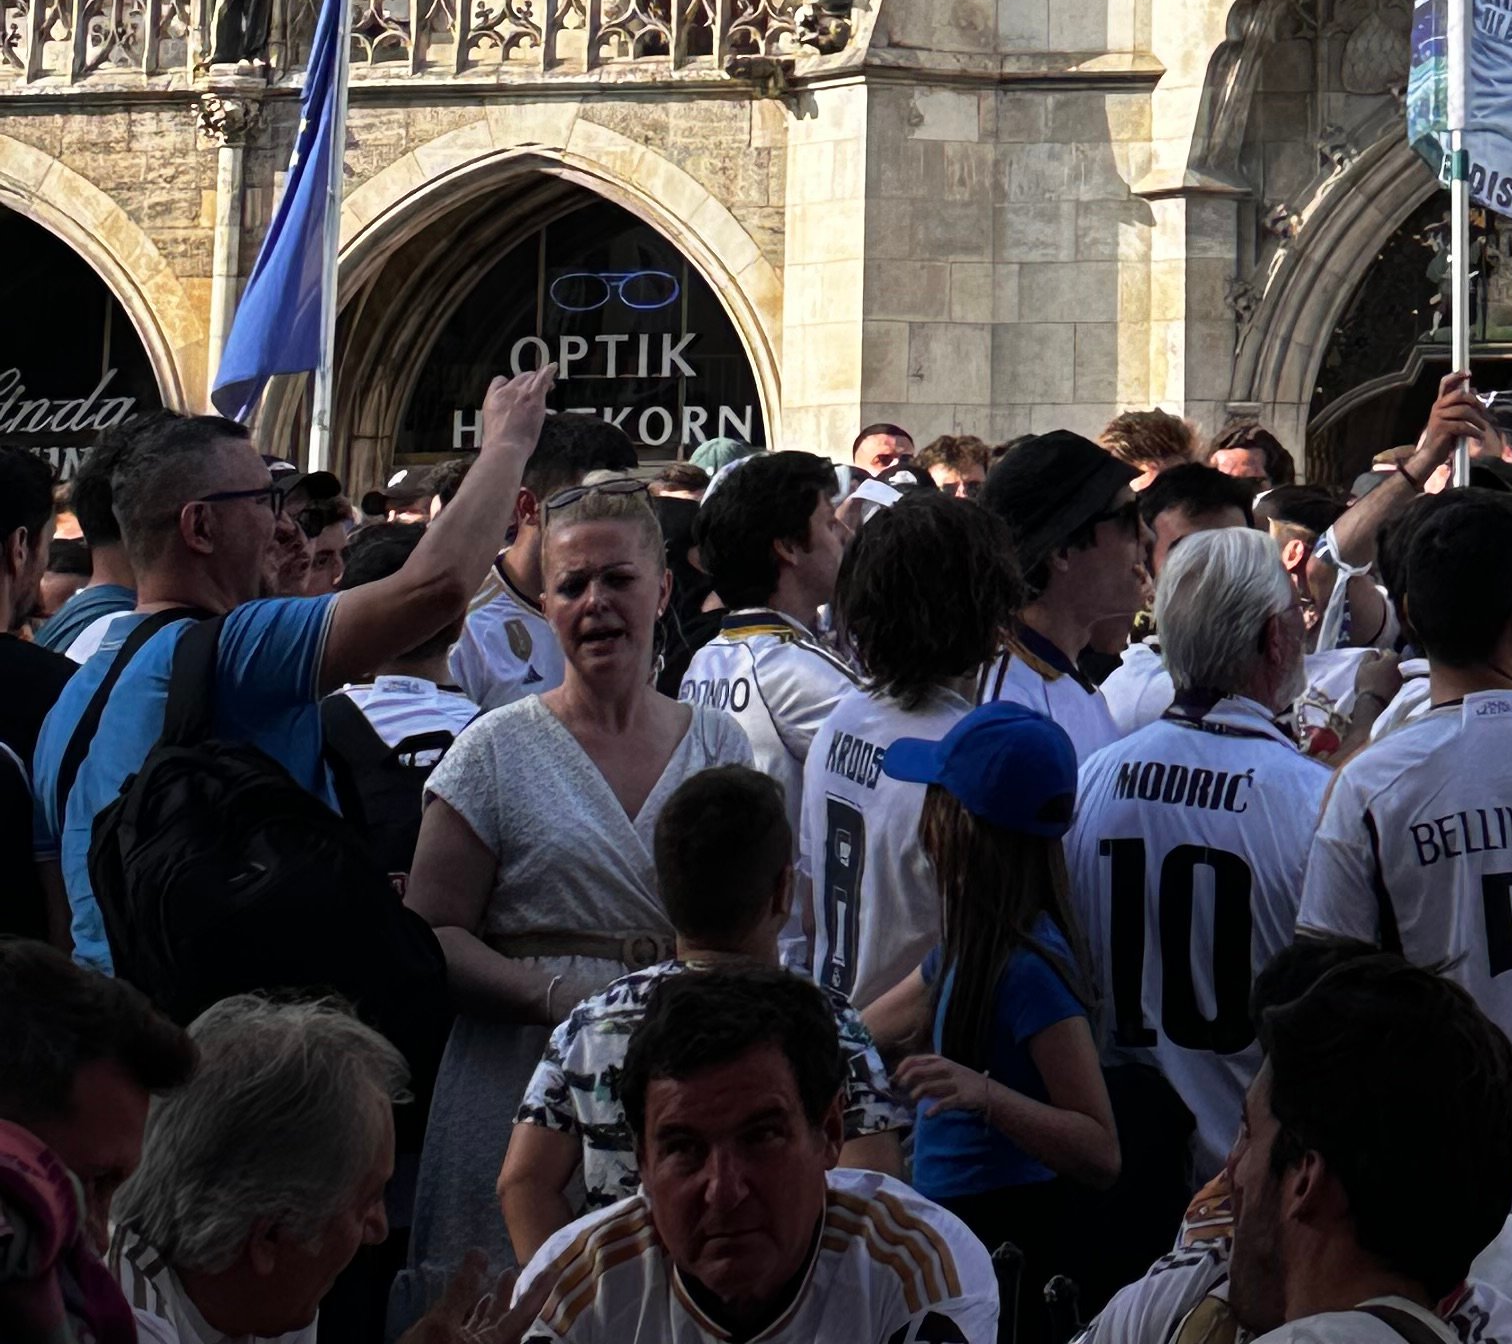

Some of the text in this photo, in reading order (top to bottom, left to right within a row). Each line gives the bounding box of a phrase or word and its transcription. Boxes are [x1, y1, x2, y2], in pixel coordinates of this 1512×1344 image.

[510, 333, 698, 379] OPTIK
[1114, 760, 1255, 813] MODRIĆ
[1098, 837, 1256, 1055] 10
